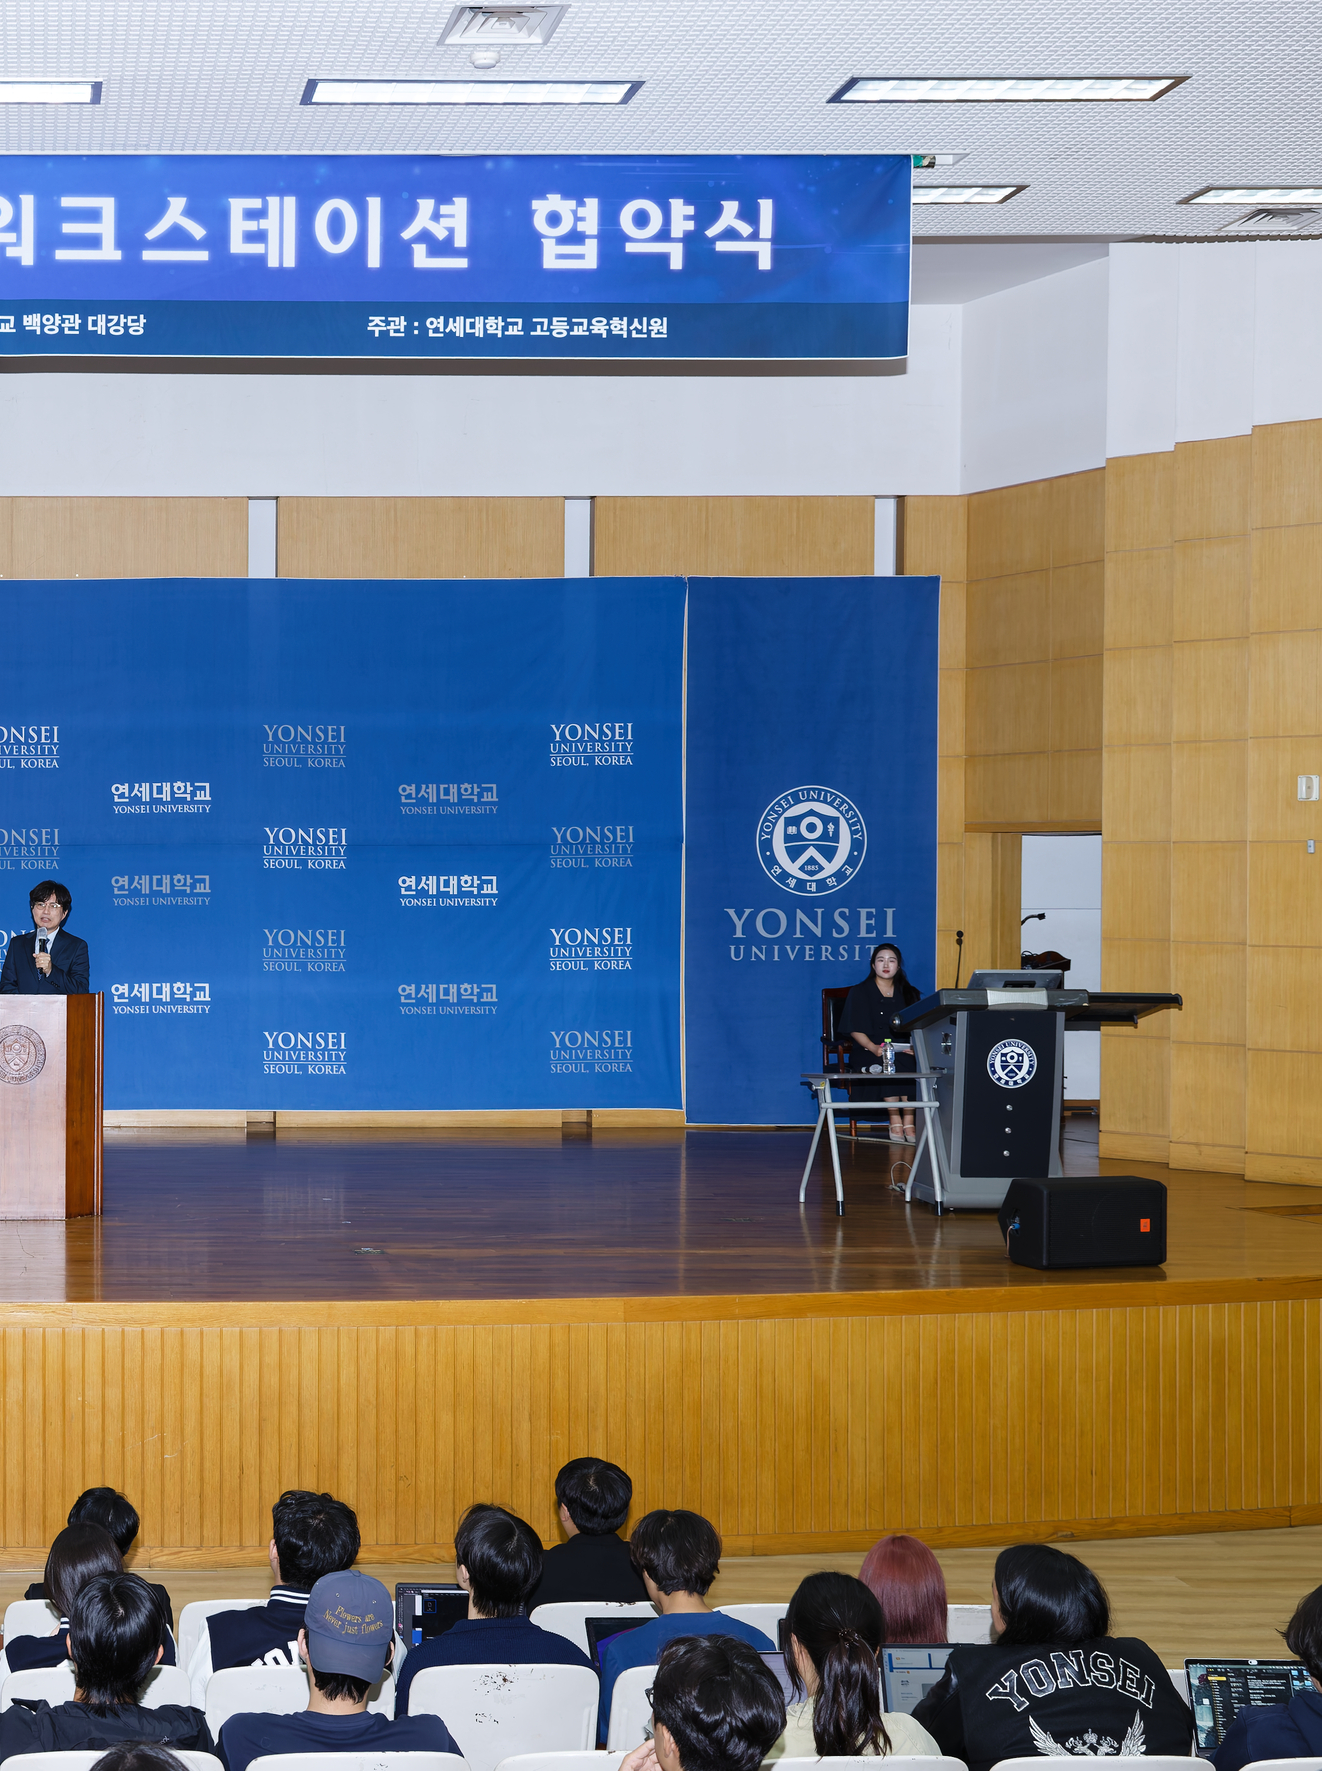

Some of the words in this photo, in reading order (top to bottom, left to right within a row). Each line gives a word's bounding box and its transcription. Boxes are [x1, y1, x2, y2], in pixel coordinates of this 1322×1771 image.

[531, 193, 773, 271] 협약식
[22, 312, 82, 335] 백양관
[87, 313, 147, 336] 대강당
[366, 315, 408, 338] 주관
[425, 315, 525, 338] 연세대학교
[529, 316, 668, 339] 고등교육혁신원
[263, 725, 346, 743] YONSEI
[550, 723, 633, 741] YONSEI
[263, 744, 346, 754] UNIVERSITY
[550, 742, 633, 753] UNIVERSITY
[20, 759, 59, 768] KOREA
[263, 758, 302, 768] SEOUL,
[308, 758, 346, 767] KOREA
[550, 757, 589, 767] SEOUL,
[594, 756, 633, 766] KOREA
[111, 781, 212, 802] 연세대학교
[398, 783, 499, 803] 연세대학교
[112, 805, 150, 814] YONSEI
[152, 804, 212, 814] UNIVERSITY
[400, 807, 437, 815] YONSEI
[439, 806, 499, 814] UNIVERSITY
[761, 796, 795, 842] YONSEI
[799, 790, 863, 842] UNIVERSITY
[263, 827, 347, 845] YONSEI
[551, 826, 635, 844] YONSEI
[263, 846, 346, 856] UNIVERSITY
[550, 844, 633, 855] UNIVERSITY
[20, 860, 59, 870] KOREA
[263, 859, 302, 869] SEOUL,
[308, 859, 346, 869] KOREA
[550, 858, 589, 868] SEOUL,
[594, 858, 633, 868] KOREA
[111, 874, 212, 895] 연세대학교
[398, 875, 499, 895] 연세대학교
[771, 865, 854, 892] 연세대학교
[112, 897, 150, 906] YONSEI
[152, 897, 211, 906] UNIVERSITY
[399, 898, 437, 907] YONSEI
[439, 898, 498, 906] UNIVERSITY
[724, 907, 897, 939] YONSEI
[263, 929, 346, 947] YONSEI
[550, 928, 633, 946] YONSEI
[263, 948, 346, 958] UNIVERSITY
[549, 947, 633, 958] UNIVERSITY
[730, 944, 897, 961] UNIVERSIT
[263, 962, 302, 972] SEOUL,
[307, 962, 346, 972] KOREA
[550, 961, 588, 971] SEOUL,
[594, 961, 632, 971] KOREA
[111, 982, 212, 1003] 연세대학교
[397, 983, 499, 1003] 연세대학교
[112, 1006, 150, 1014] YONSEI
[152, 1005, 211, 1014] UNIVERSITY
[399, 1007, 437, 1015] YONSEI
[439, 1006, 498, 1014] UNIVERSITY
[262, 1032, 347, 1049] YONSEI
[550, 1031, 633, 1048] YONSEI
[263, 1051, 347, 1061] UNIVERSITY
[550, 1049, 633, 1060] UNIVERSITY
[263, 1065, 302, 1075] SEOUL,
[308, 1064, 347, 1075] KOREA
[550, 1063, 589, 1073] SEOUL,
[594, 1063, 633, 1073] KOREA
[323, 1608, 342, 1629] Never
[342, 1622, 358, 1635] just
[361, 1620, 384, 1635] flowers
[335, 1605, 362, 1624] Flowers
[364, 1613, 375, 1622] are
[985, 1649, 1156, 1713] YONSEI
